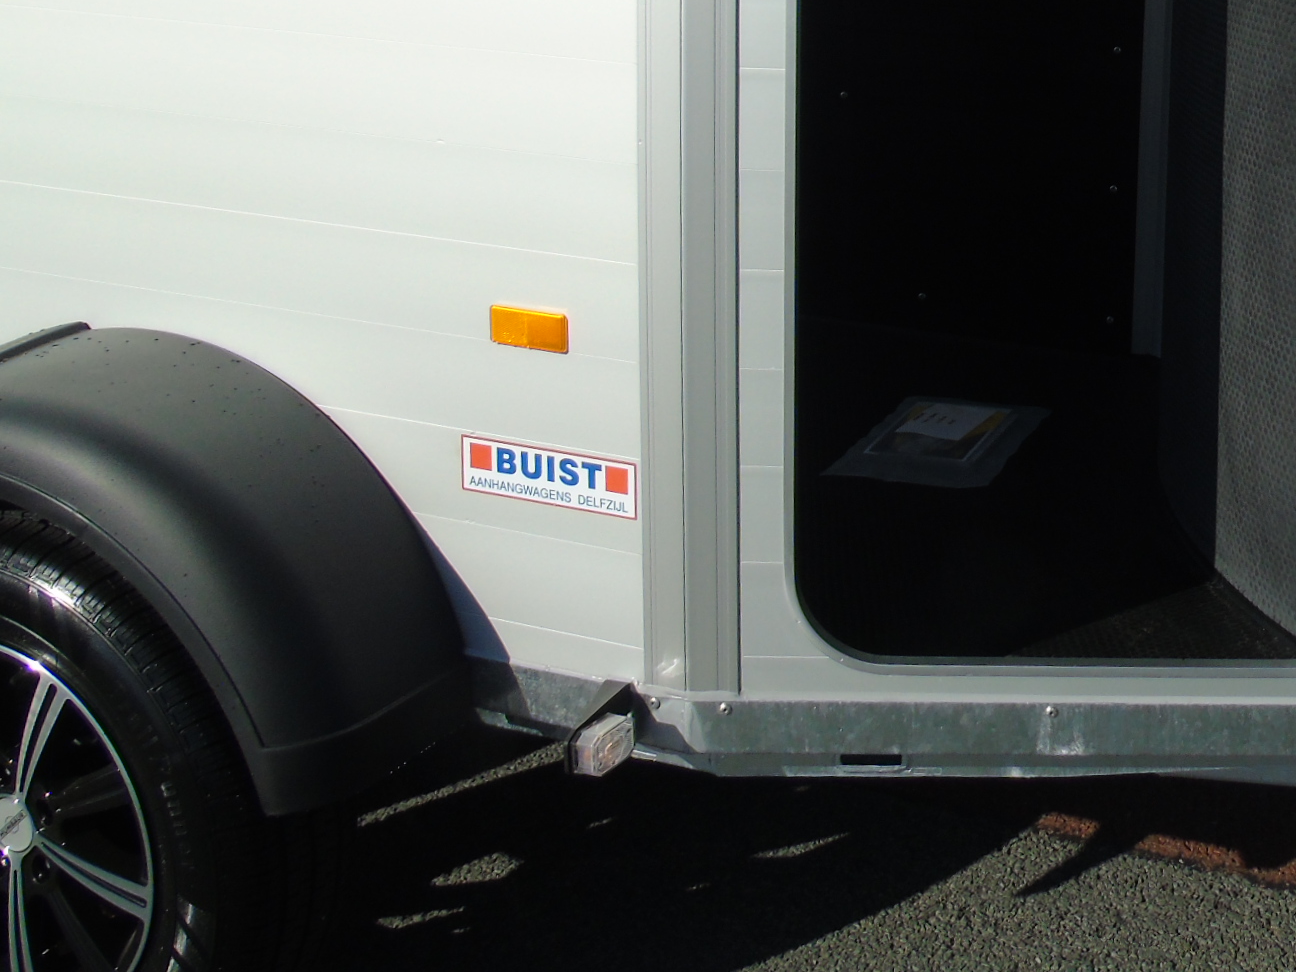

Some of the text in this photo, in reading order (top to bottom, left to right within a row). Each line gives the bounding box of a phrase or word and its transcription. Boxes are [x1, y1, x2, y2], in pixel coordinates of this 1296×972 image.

[496, 446, 603, 490] BUIST
[469, 475, 629, 514] AANHANGWAGENS DELFZIJL
